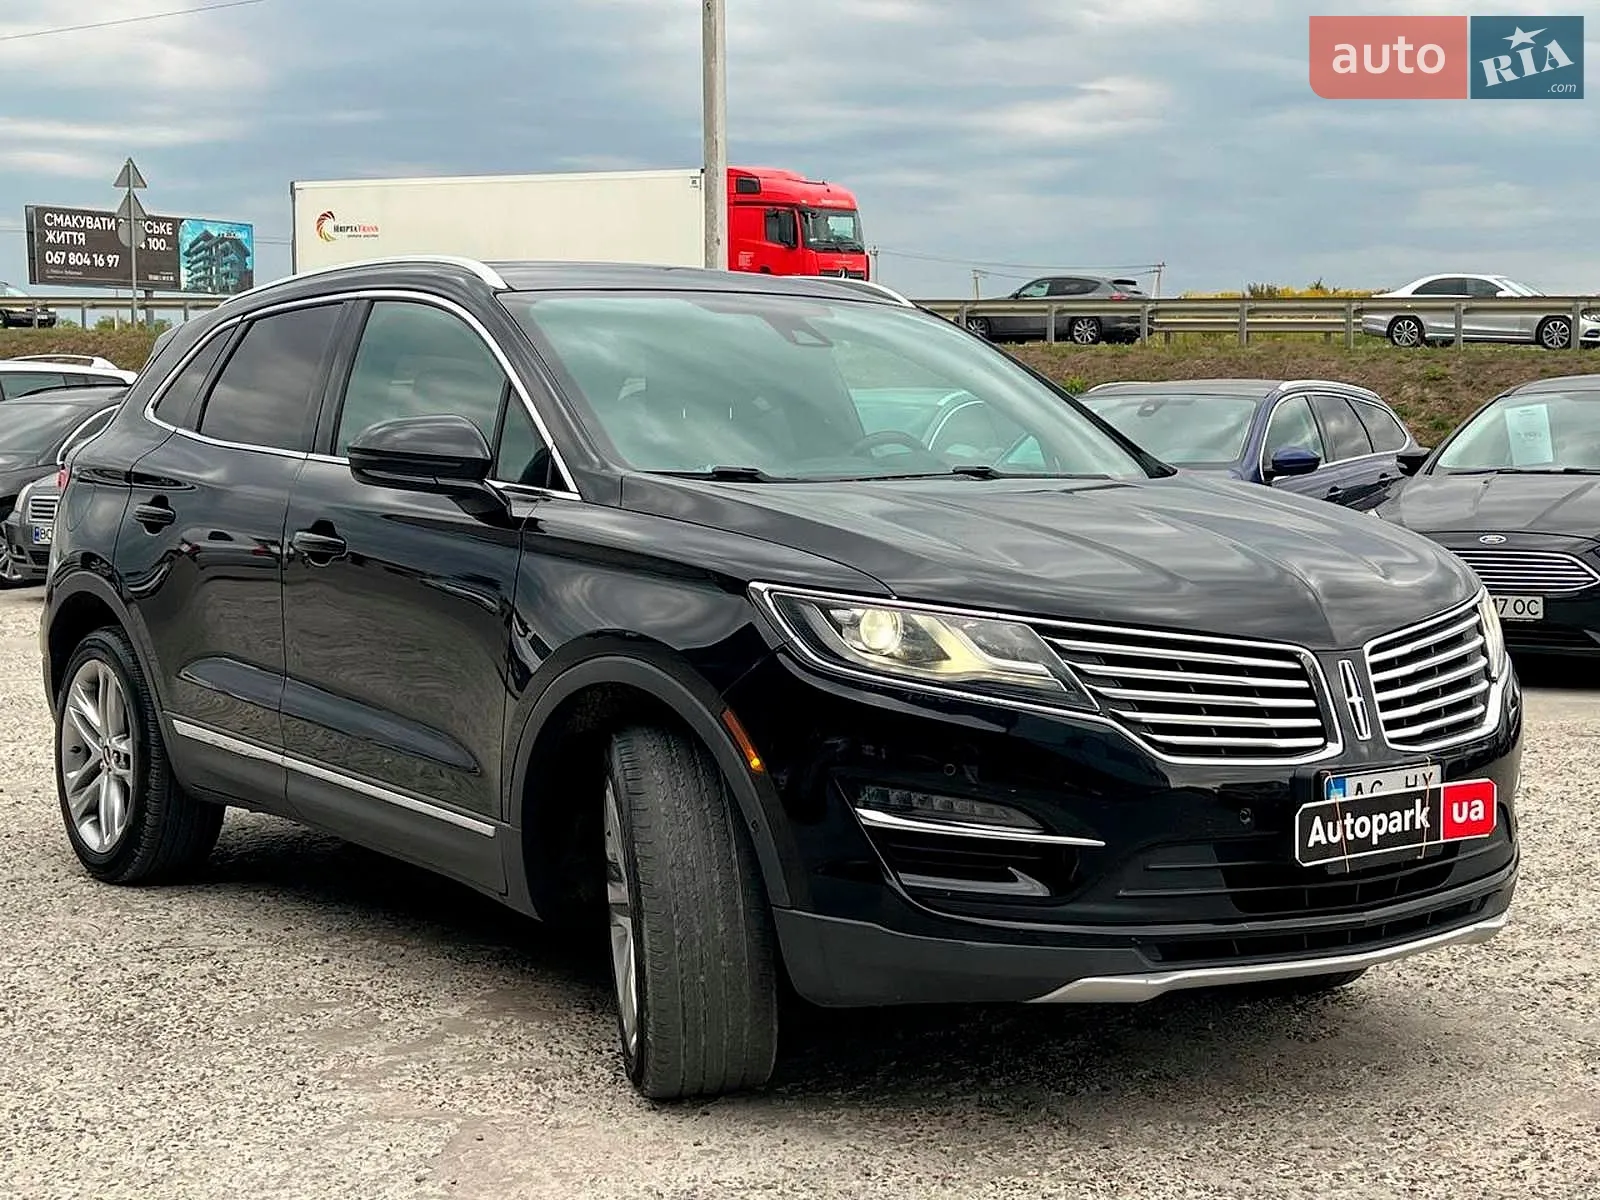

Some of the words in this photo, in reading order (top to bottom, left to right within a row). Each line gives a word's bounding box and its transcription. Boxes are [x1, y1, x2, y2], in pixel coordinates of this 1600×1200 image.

[44, 212, 116, 231] СМАКУВАТИ
[45, 229, 86, 246] ЖИТТЯ
[147, 237, 167, 251] 100
[45, 250, 66, 265] 067
[68, 252, 91, 266] 804
[92, 254, 105, 268] 16
[106, 254, 120, 268] 97
[1513, 599, 1539, 616] OC
[1308, 799, 1431, 848] Autopark
[1452, 799, 1485, 823] ua
